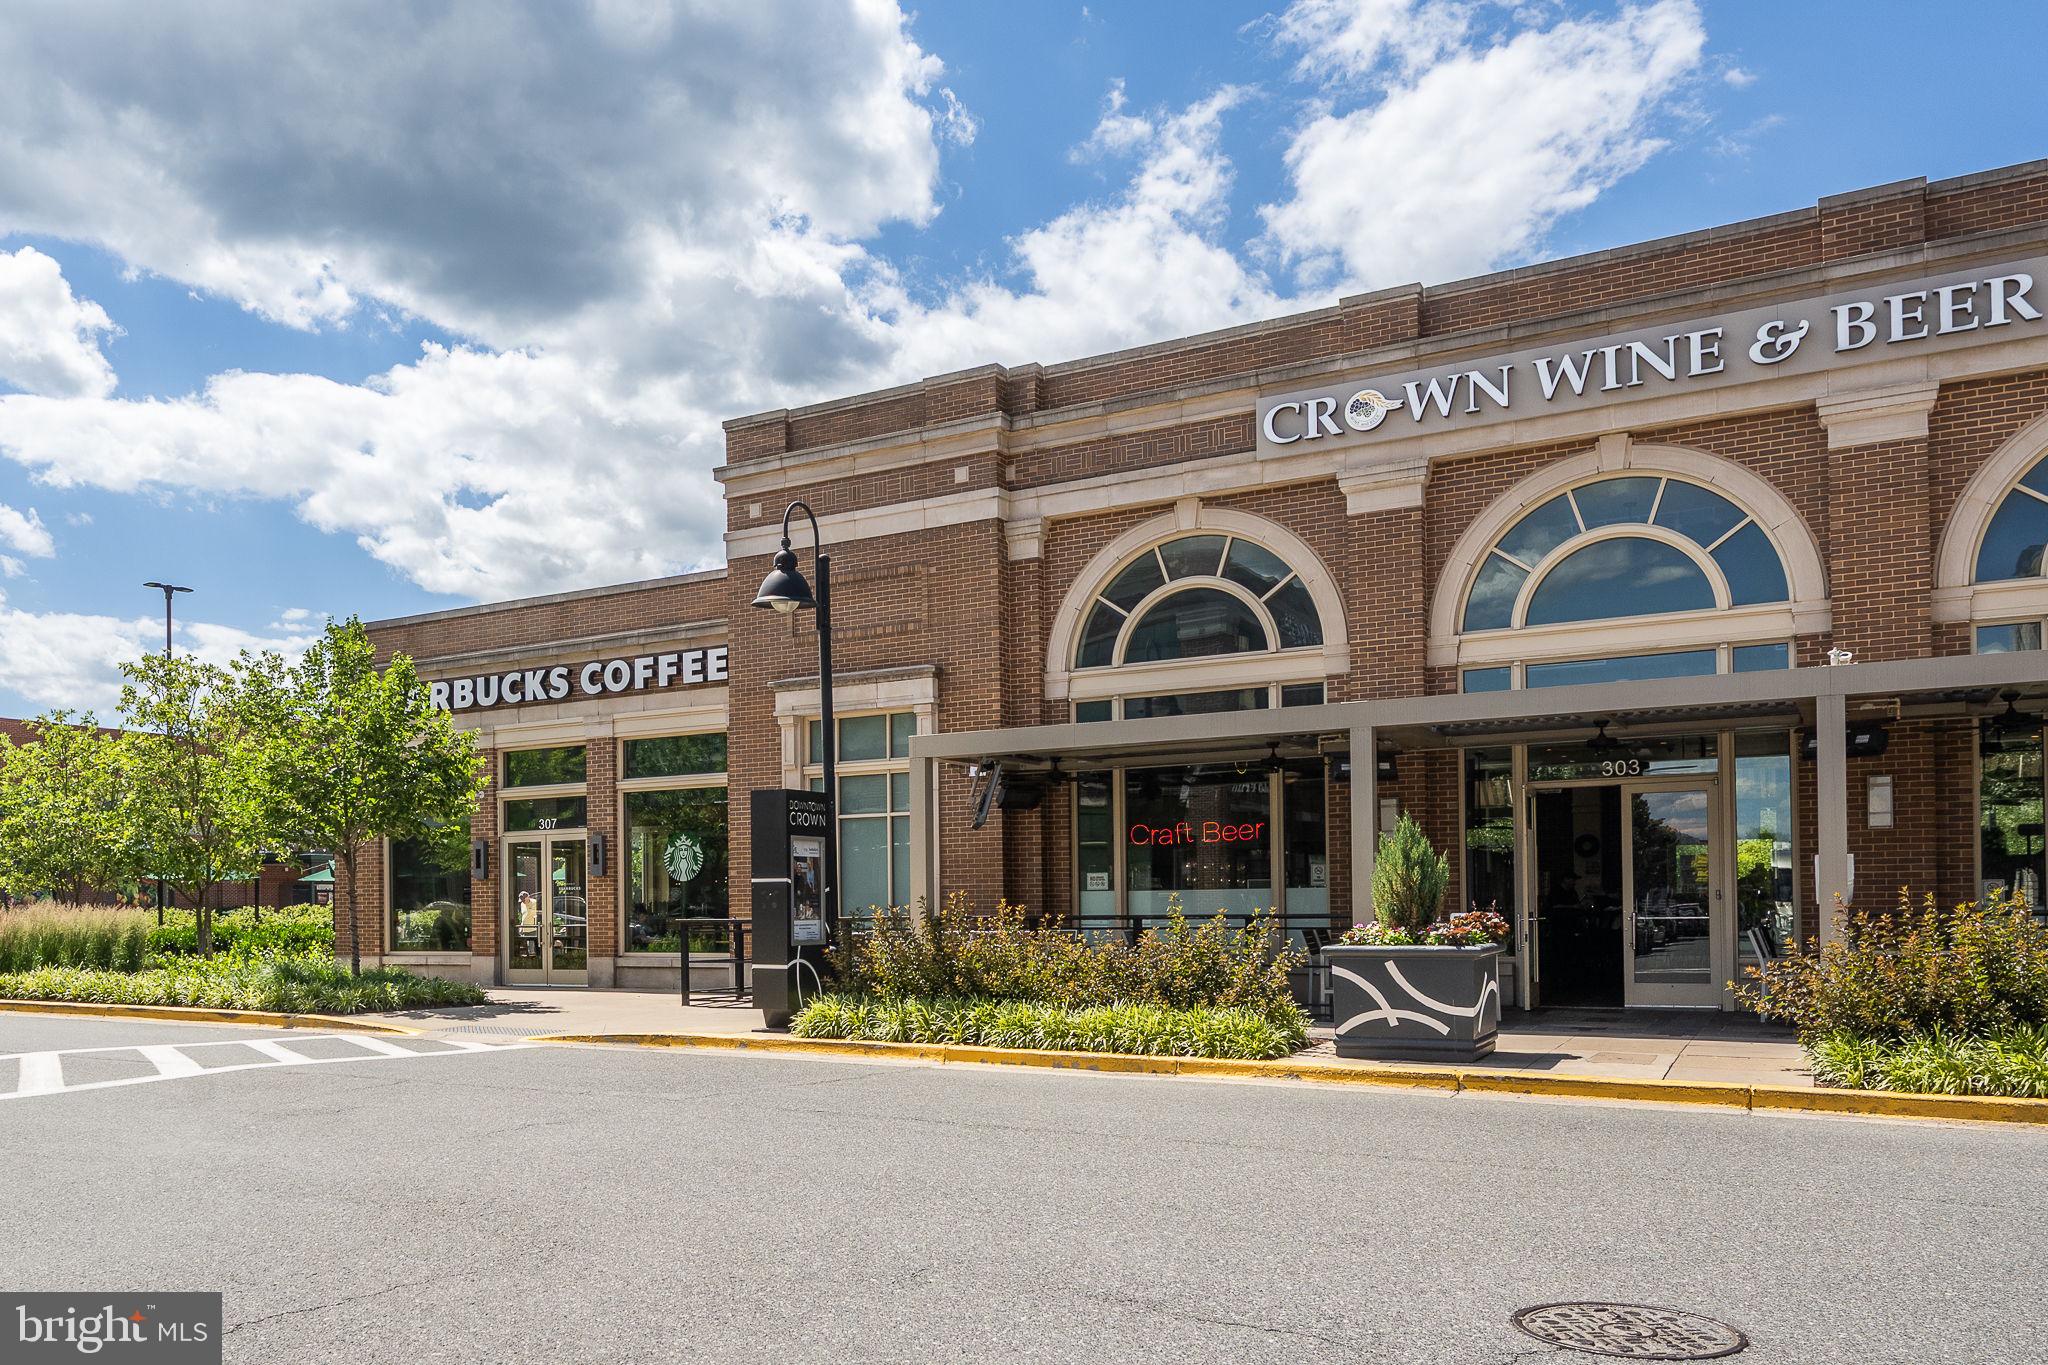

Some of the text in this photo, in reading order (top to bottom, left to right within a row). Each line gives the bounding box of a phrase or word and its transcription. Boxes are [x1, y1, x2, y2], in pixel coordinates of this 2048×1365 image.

[1532, 326, 1725, 400] WINE
[1748, 319, 1810, 365] &
[1830, 273, 2044, 353] BEER
[580, 647, 728, 695] COFFEE
[1602, 759, 1640, 776] 303
[789, 800, 826, 812] DOWNTOWN
[538, 818, 557, 830] 307
[789, 811, 826, 827] CROWN
[1130, 821, 1265, 845] Craft Beer
